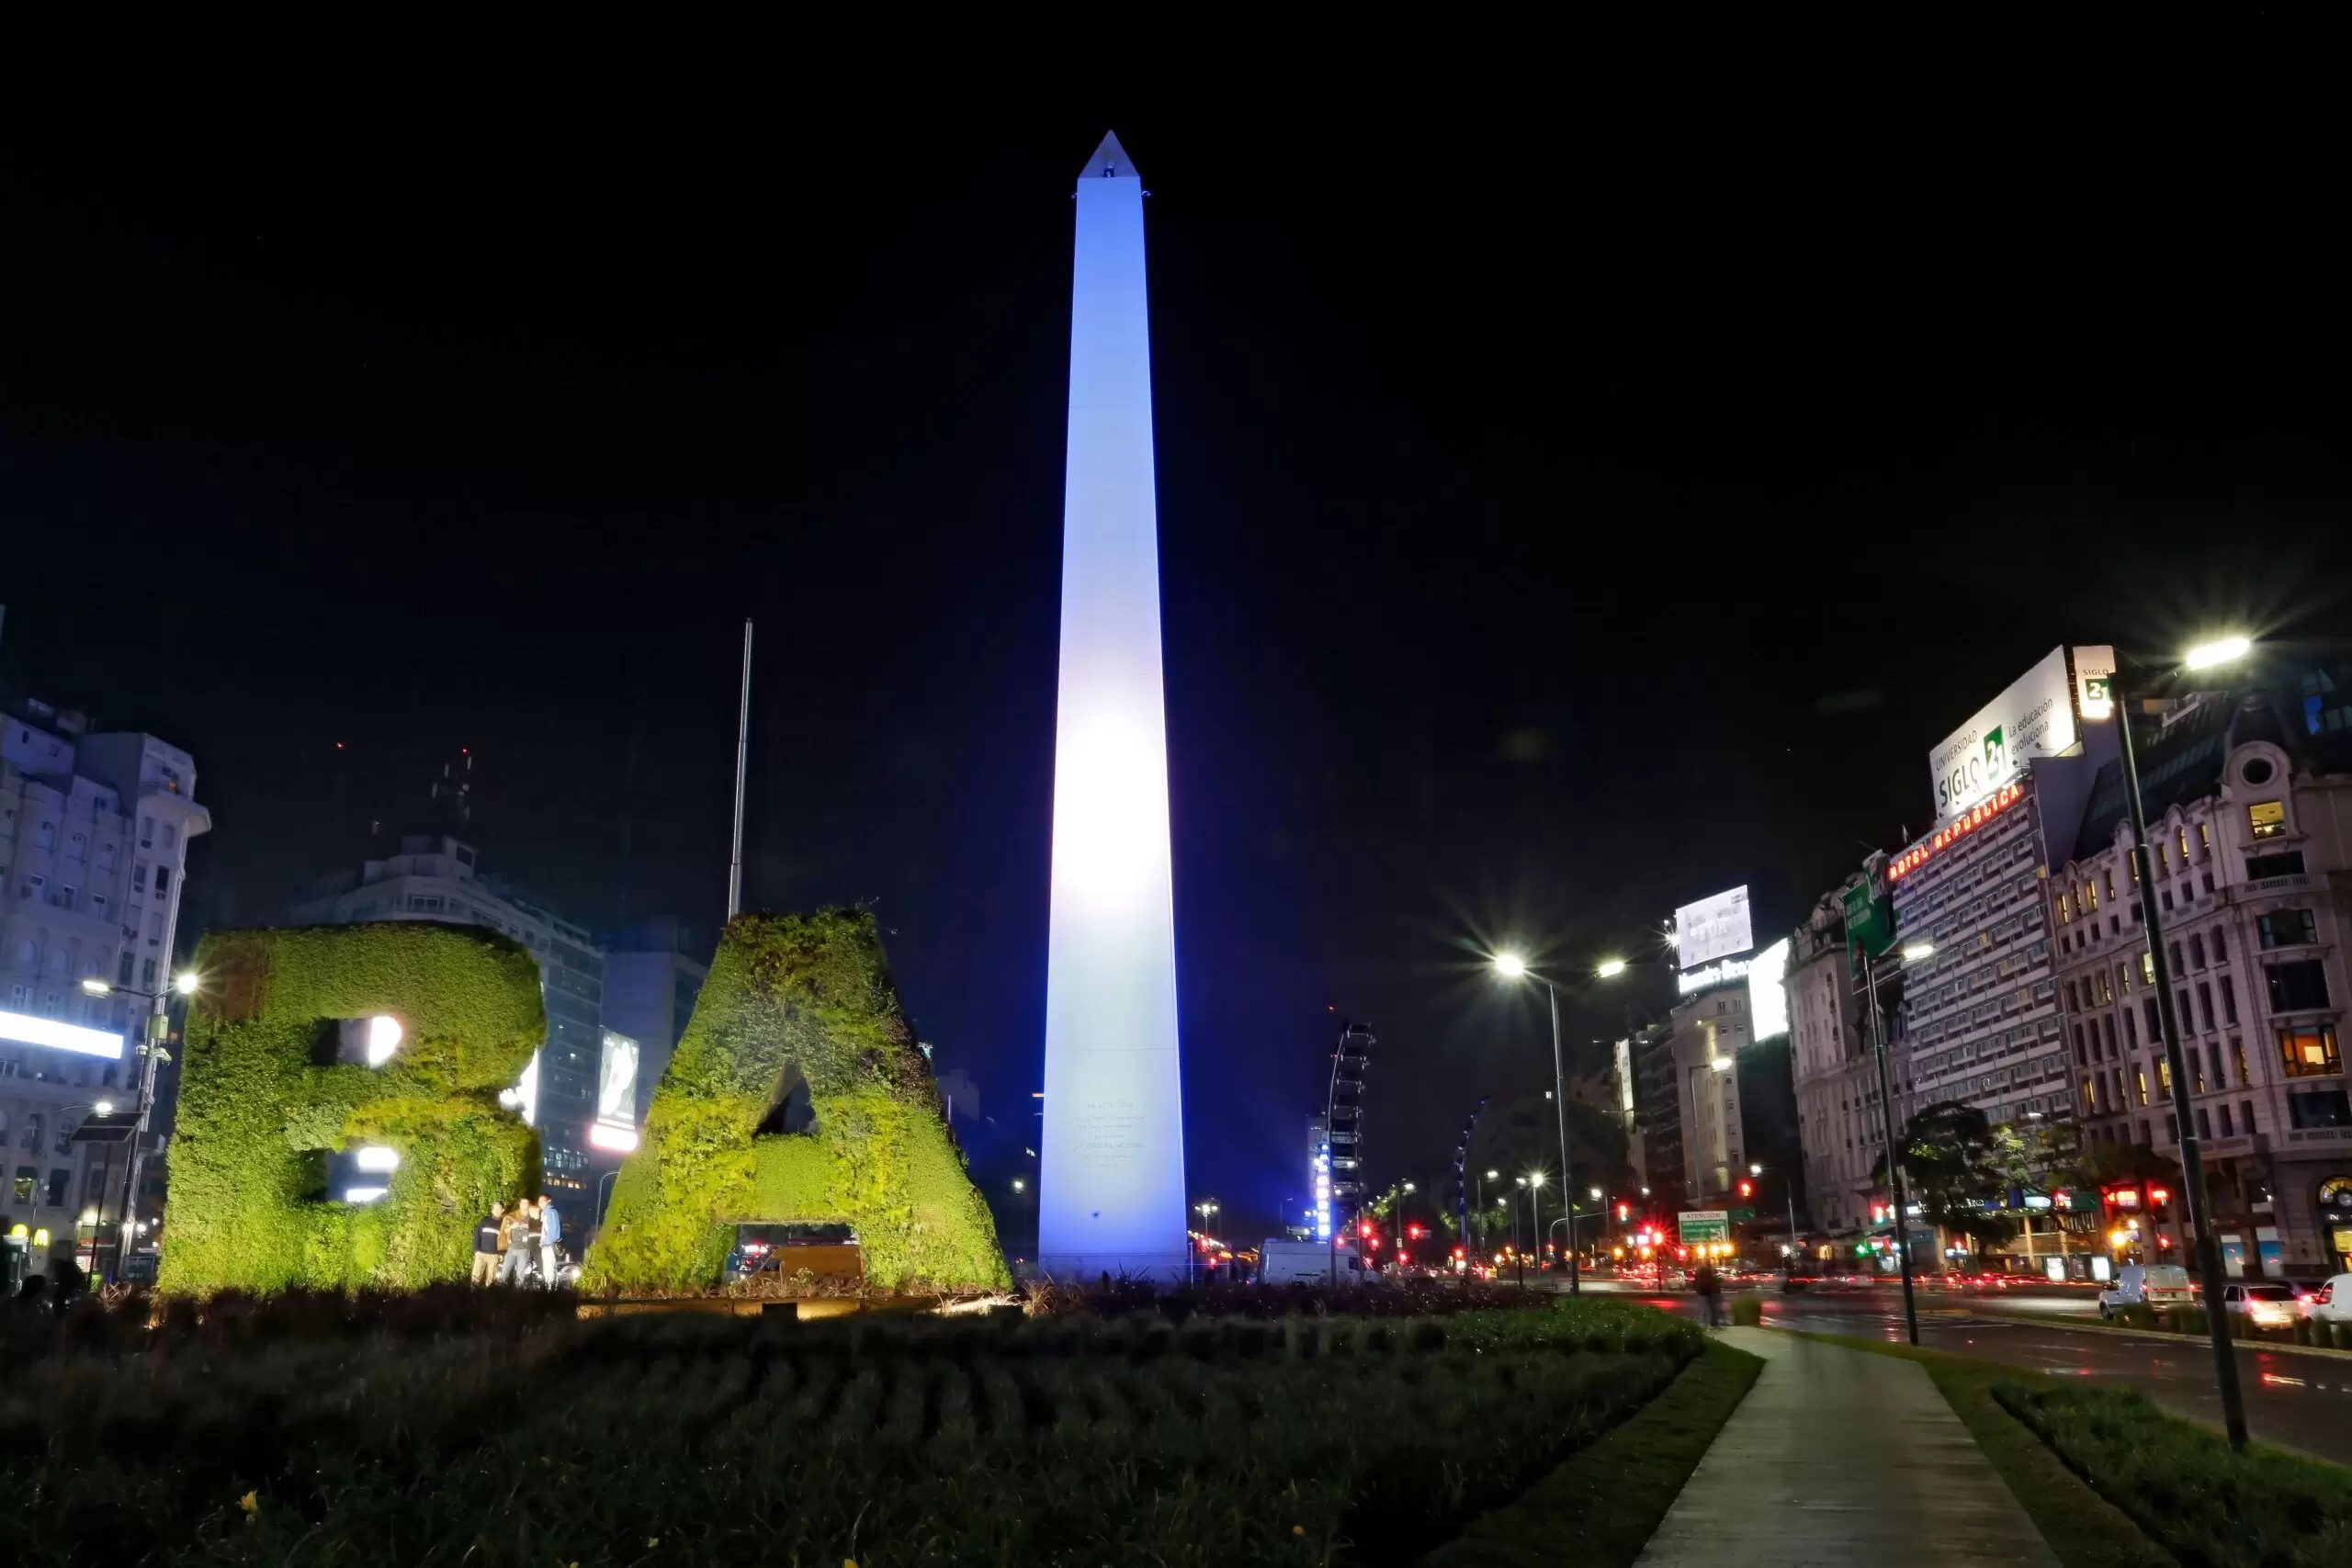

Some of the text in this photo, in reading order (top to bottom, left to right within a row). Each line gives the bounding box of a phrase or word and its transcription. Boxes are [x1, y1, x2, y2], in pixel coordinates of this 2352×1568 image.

[2008, 698, 2053, 739] La educación
[2011, 721, 2049, 754] evoluciona
[1936, 729, 1977, 772] UNIVERSIDAD
[1939, 756, 1981, 807] SIGLO
[1889, 844, 1928, 879] HOTEL
